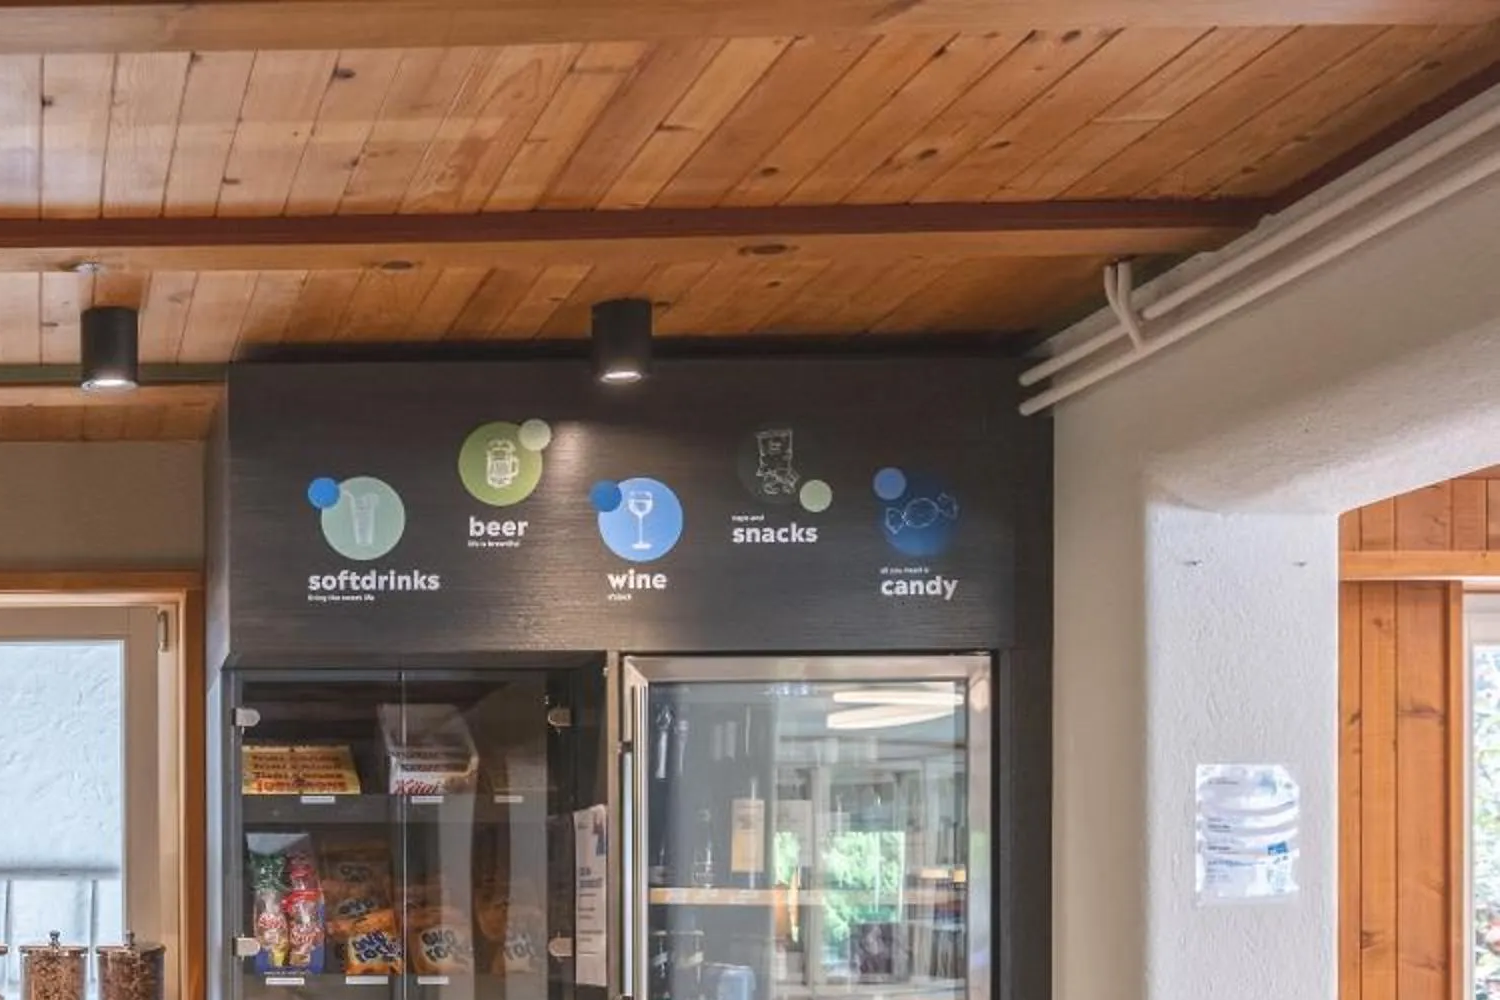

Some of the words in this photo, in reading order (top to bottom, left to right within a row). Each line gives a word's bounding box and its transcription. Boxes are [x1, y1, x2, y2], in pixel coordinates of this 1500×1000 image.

[469, 516, 529, 537] beer
[732, 522, 819, 543] snacks
[308, 569, 440, 591] softdrinks
[607, 569, 668, 590] wine
[881, 575, 959, 601] candy
